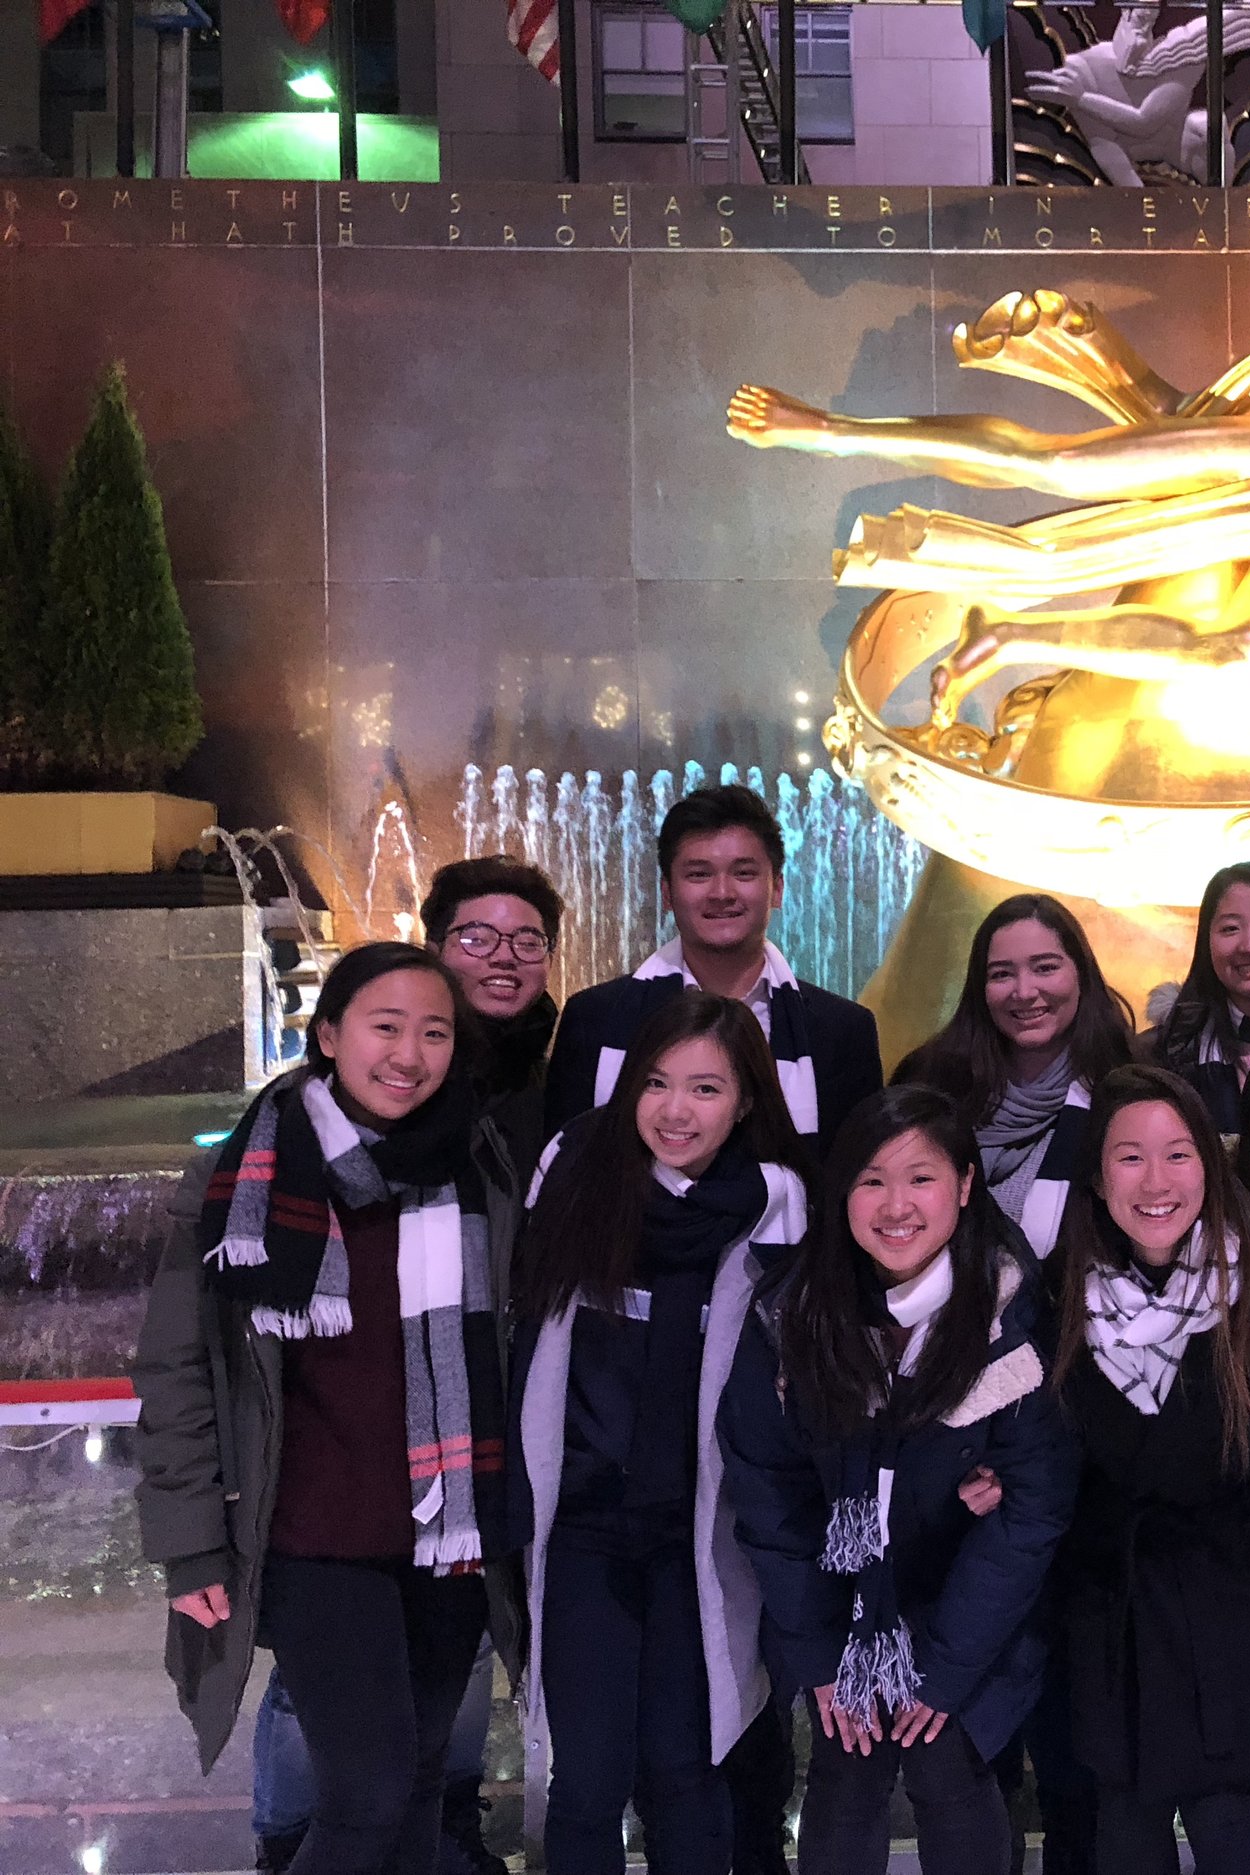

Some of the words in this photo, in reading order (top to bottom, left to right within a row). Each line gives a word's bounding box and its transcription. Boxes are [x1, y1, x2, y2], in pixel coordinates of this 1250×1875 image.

[557, 194, 893, 217] TEACHER
[988, 195, 1052, 216] IN
[171, 221, 354, 245] HATH
[448, 224, 734, 248] PROVED
[827, 226, 897, 248] TO
